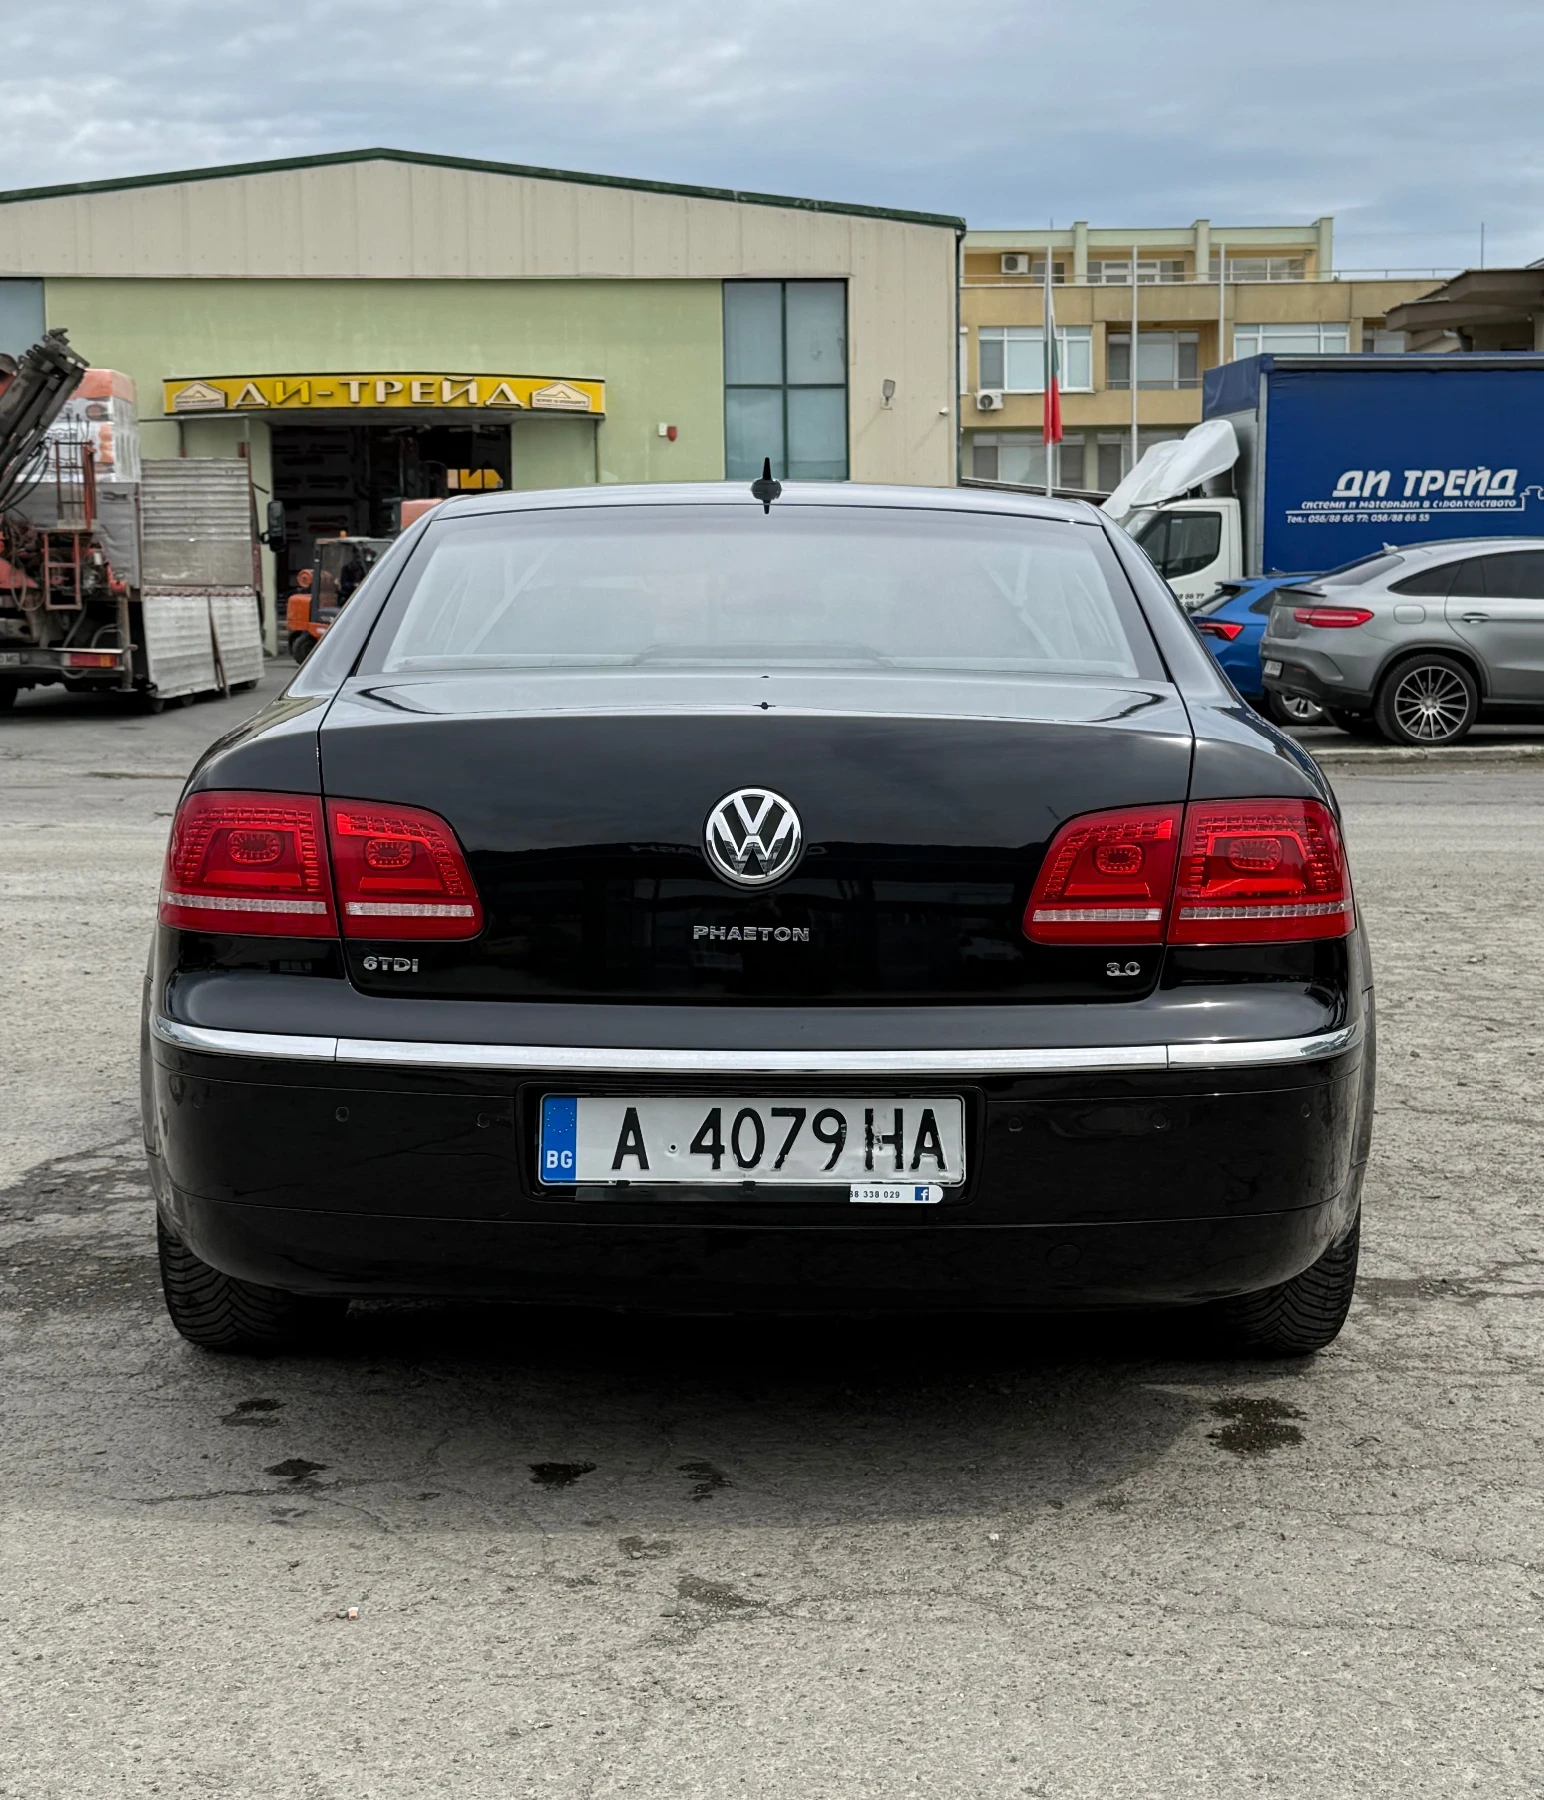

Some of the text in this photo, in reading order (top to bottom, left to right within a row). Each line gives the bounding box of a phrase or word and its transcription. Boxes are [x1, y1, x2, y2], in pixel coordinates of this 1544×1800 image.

[232, 376, 525, 407] ДИ-ТРЕЙД
[1331, 466, 1518, 498] ДИ ТРЕЙД
[693, 925, 810, 942] PHAETON
[1106, 961, 1141, 977] 3.0
[611, 1107, 650, 1170] A
[689, 1107, 848, 1170] 4079
[546, 1150, 573, 1169] BG
[863, 1190, 880, 1198] 338
[883, 1190, 900, 1198] 029
